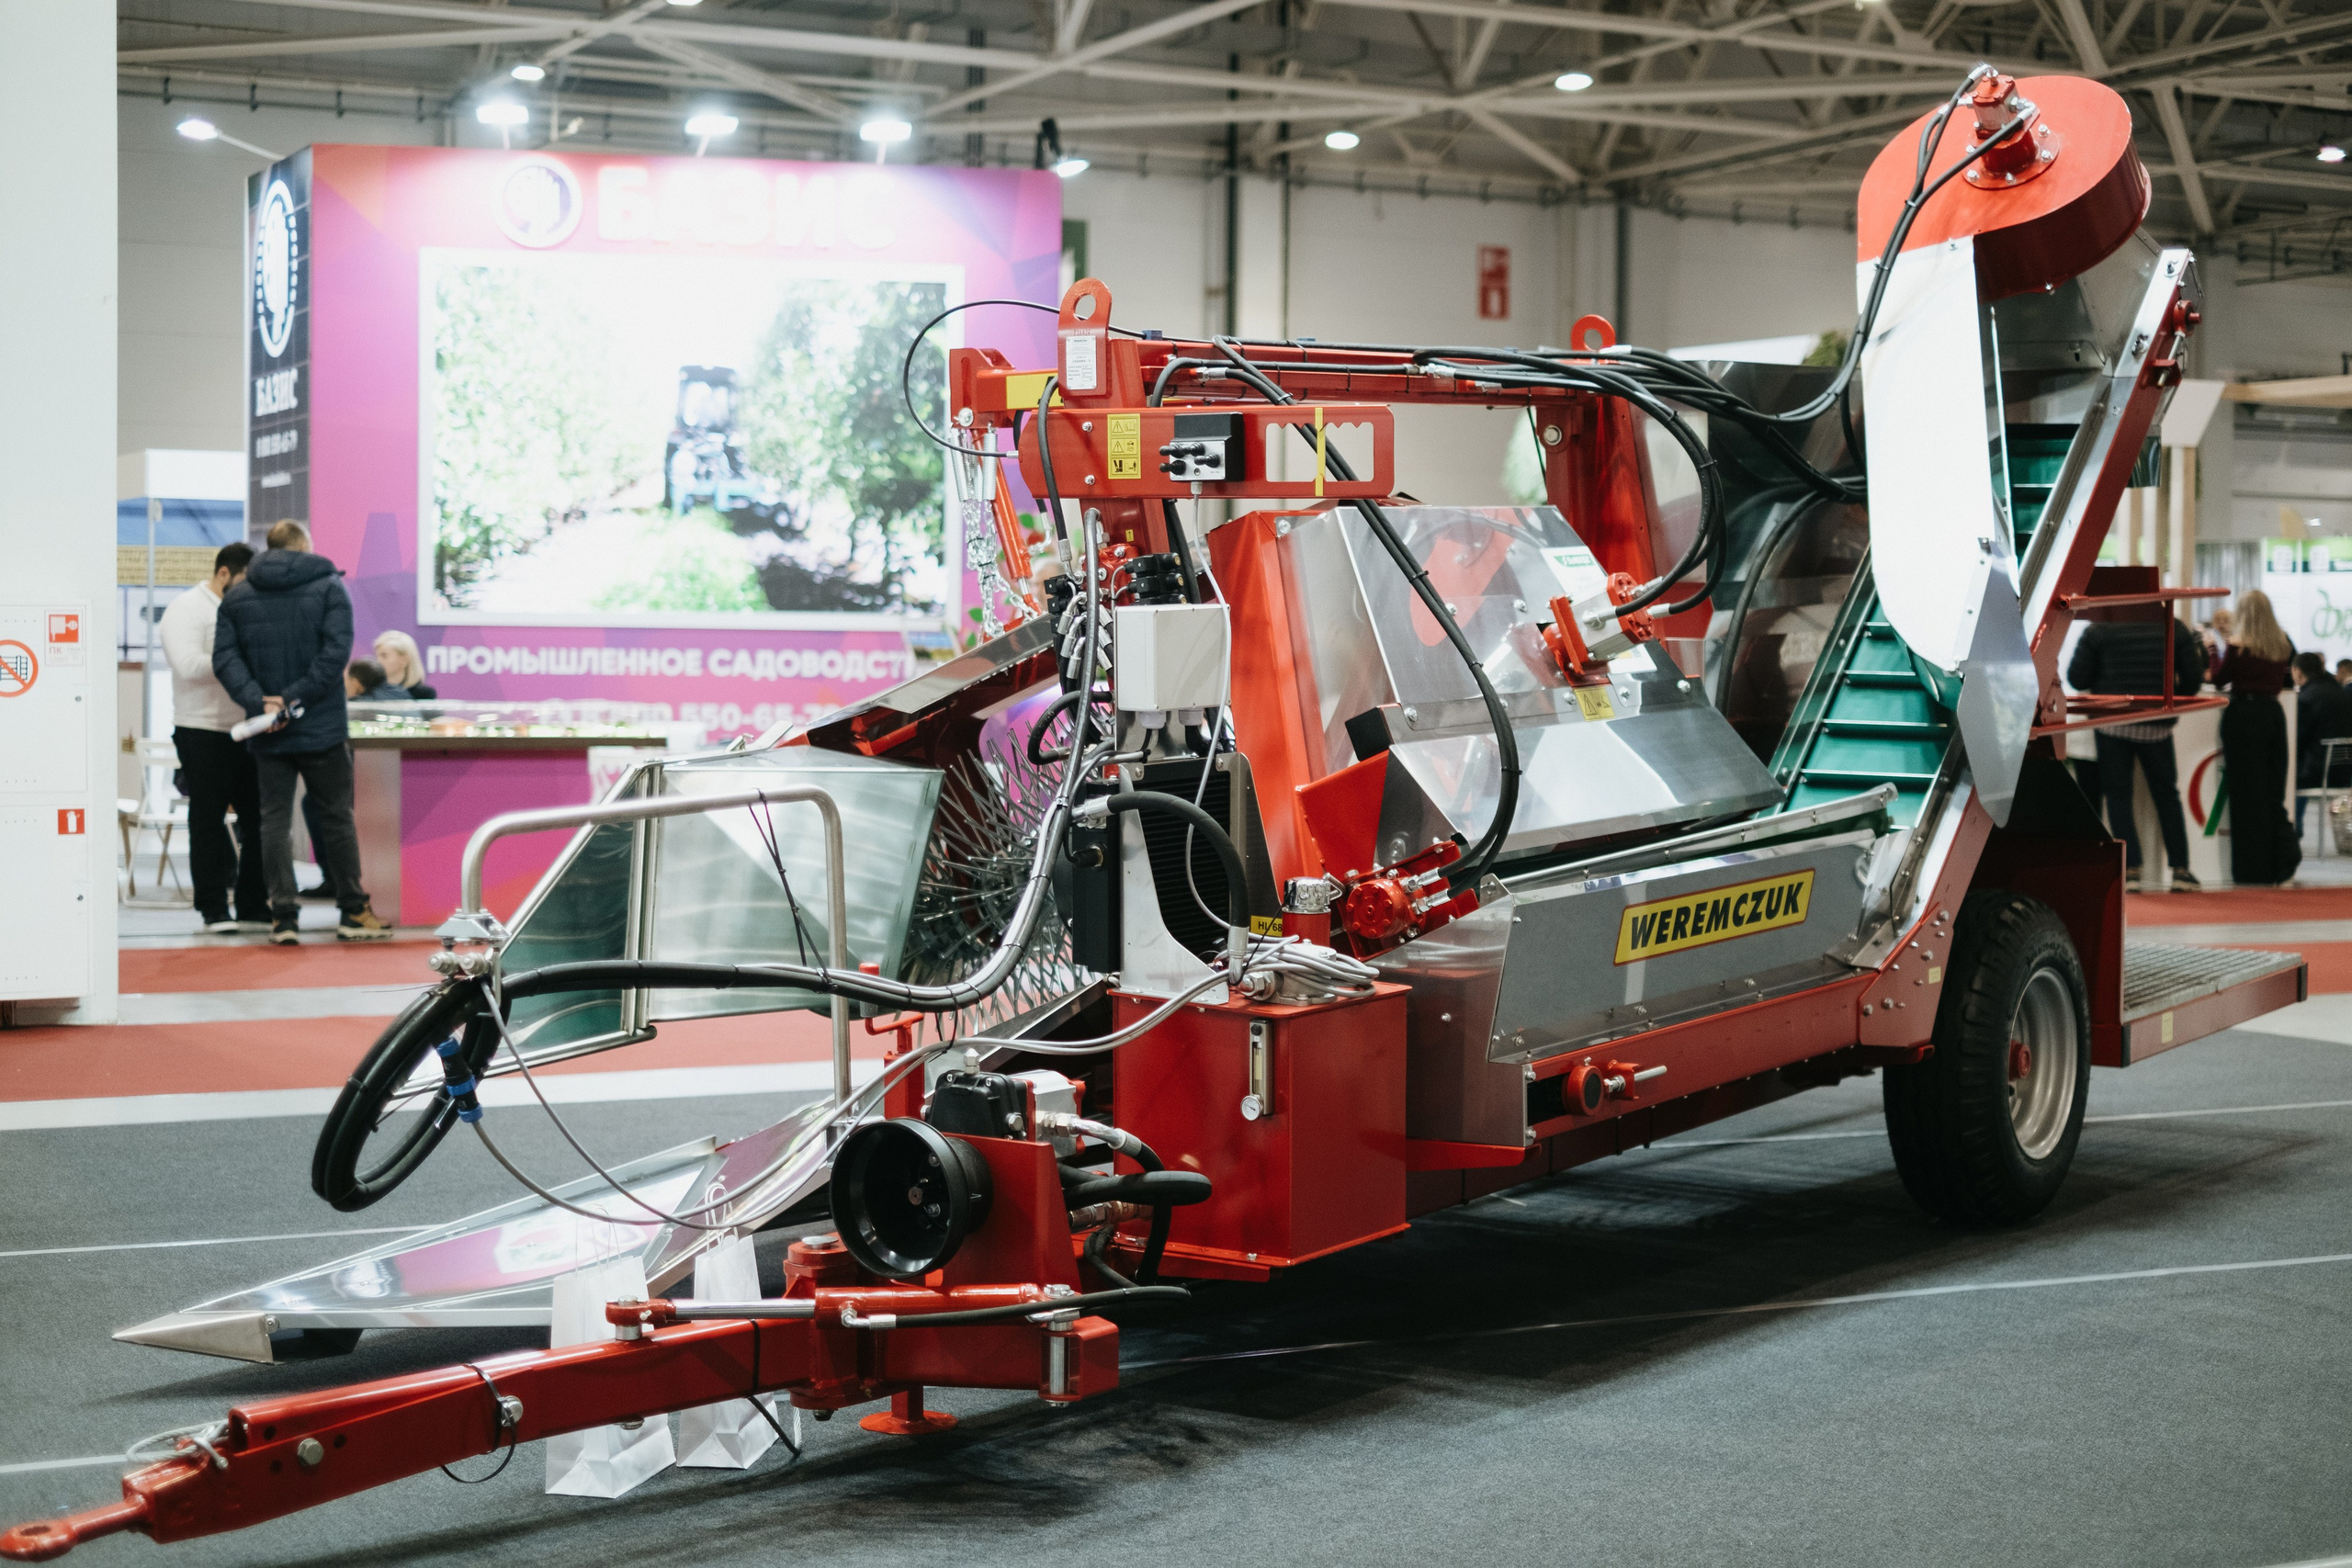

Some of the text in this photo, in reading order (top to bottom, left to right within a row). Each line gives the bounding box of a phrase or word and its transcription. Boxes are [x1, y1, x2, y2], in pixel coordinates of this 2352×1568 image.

[597, 165, 897, 249] БАЗИС
[255, 367, 299, 417] БАЗИС
[427, 645, 703, 677] ПРОМЫШЛЕННОЕ
[1630, 881, 1804, 951] WEREMCZUK
